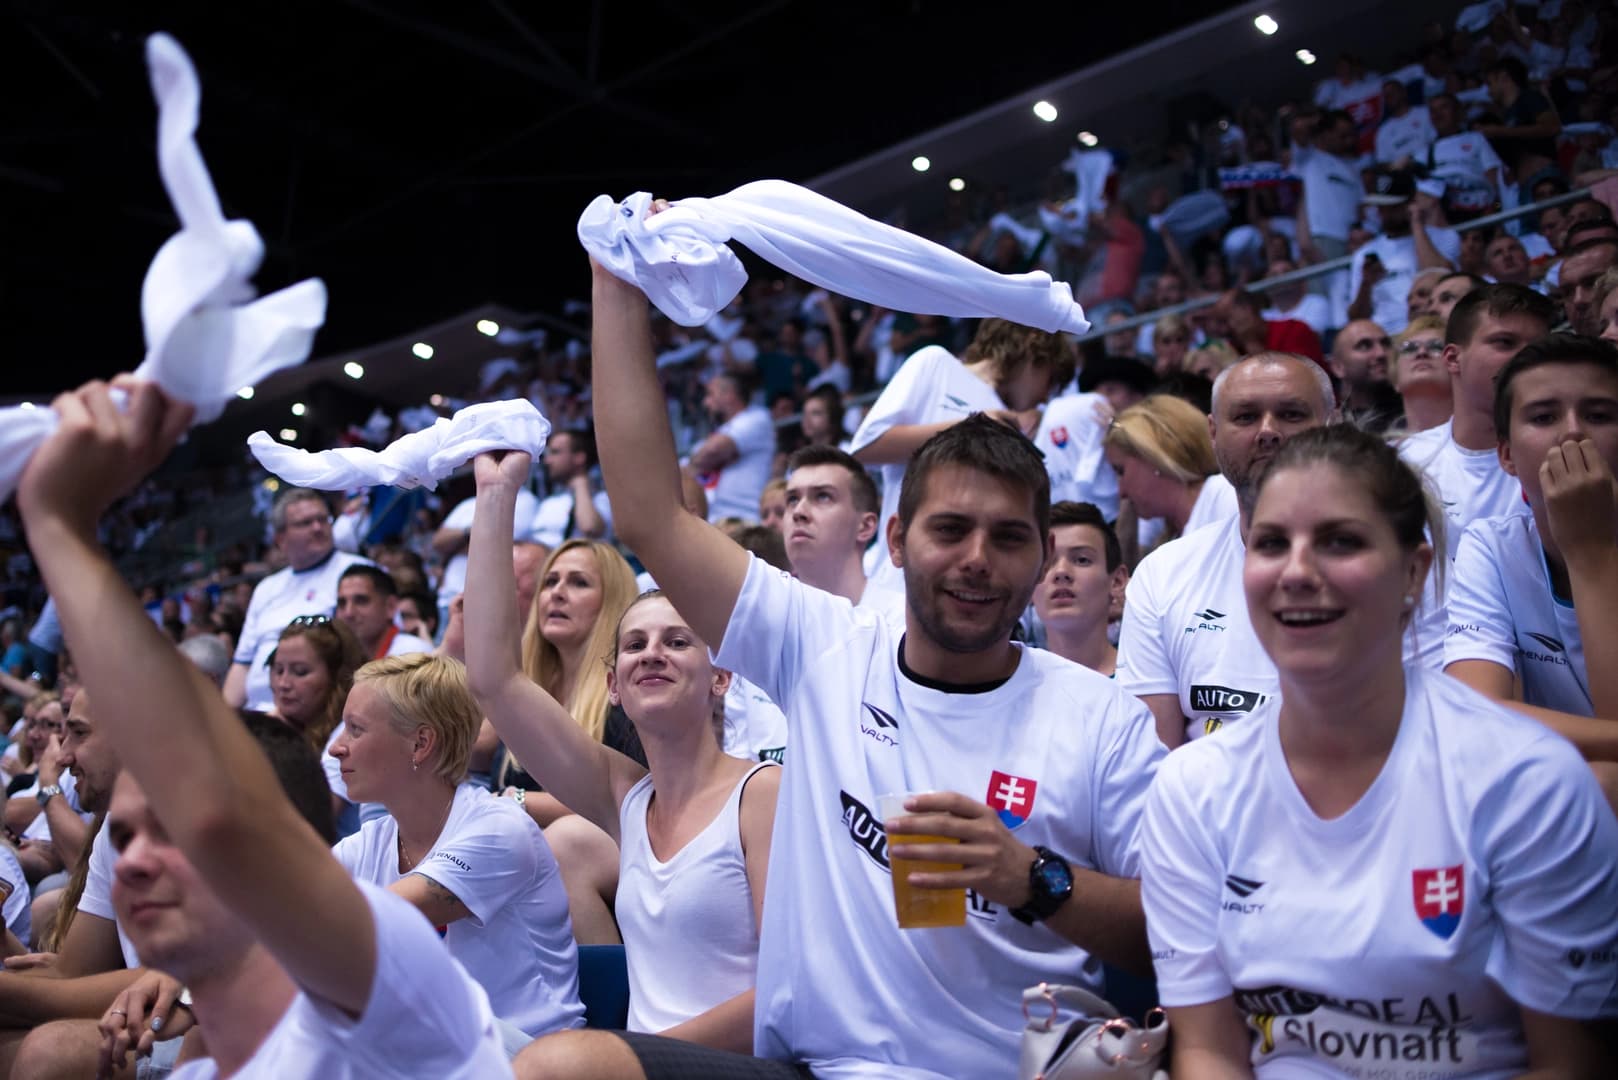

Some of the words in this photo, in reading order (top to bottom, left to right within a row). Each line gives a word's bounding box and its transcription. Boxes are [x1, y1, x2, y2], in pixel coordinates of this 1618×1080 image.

[1519, 650, 1569, 665] PENALT
[1197, 690, 1245, 707] AUTO
[1340, 992, 1473, 1029] DEAL
[1283, 1018, 1463, 1063] Slovnaft
